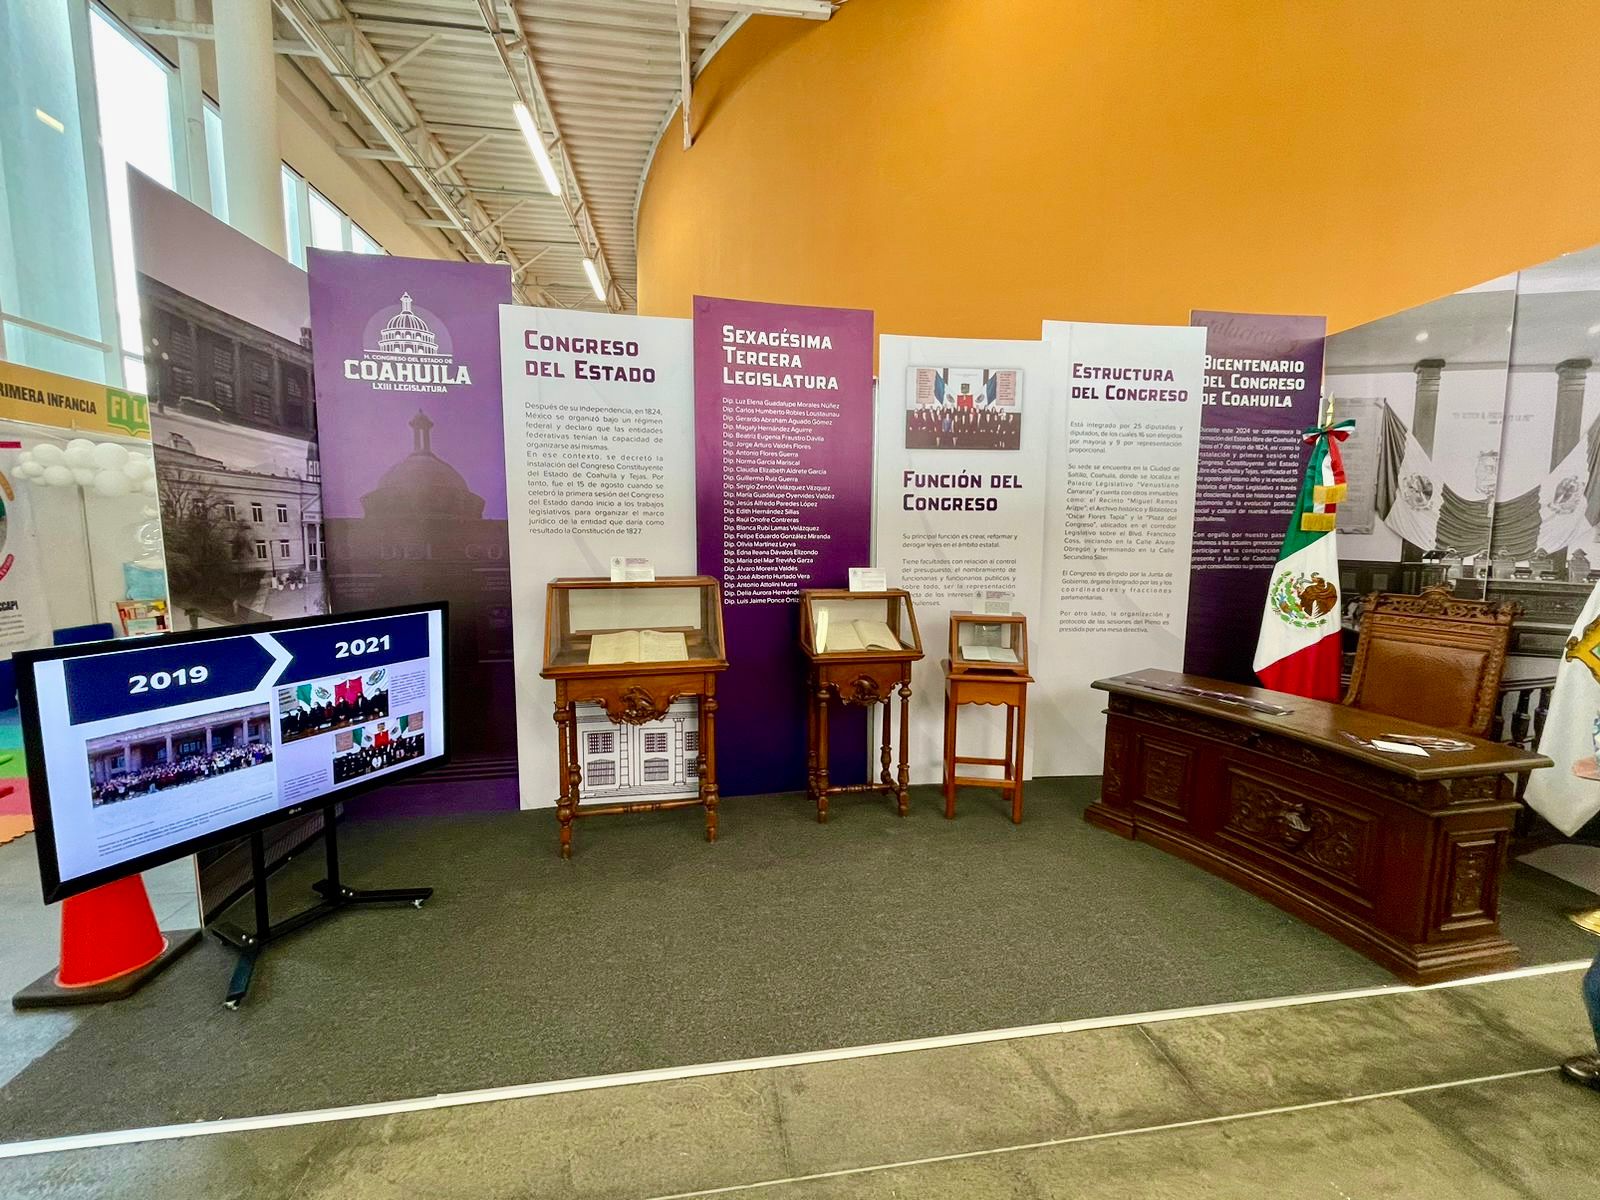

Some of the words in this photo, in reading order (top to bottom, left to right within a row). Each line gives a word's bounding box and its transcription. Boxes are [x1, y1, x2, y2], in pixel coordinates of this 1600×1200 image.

[525, 330, 639, 357] CONGRESO
[723, 325, 832, 350] SEXAGÉSIMA
[723, 346, 802, 368] TERCERA
[1204, 355, 1305, 373] BICENTENARIO
[344, 359, 472, 385] COAHUILA
[525, 360, 565, 378] DEL
[575, 360, 656, 383] ESTADO
[724, 367, 839, 390] LEGISLATURA
[1073, 363, 1174, 382] ESTRUCTURA
[1203, 376, 1226, 388] DEL
[1231, 374, 1305, 390] CONGRESO
[373, 382, 392, 390] LXIII
[394, 383, 447, 393] LEGISLATURA
[1072, 386, 1099, 400] DEL
[1105, 385, 1189, 402] CONGRESO
[47, 392, 97, 414] INFANCIA
[1202, 394, 1217, 405] DE
[1222, 391, 1292, 407] COAHUILA
[904, 470, 982, 488] FUNCIÓN
[991, 475, 1023, 489] DEL
[903, 494, 998, 511] CONGRESO
[335, 635, 390, 658] 2021
[129, 665, 208, 694] 2019
